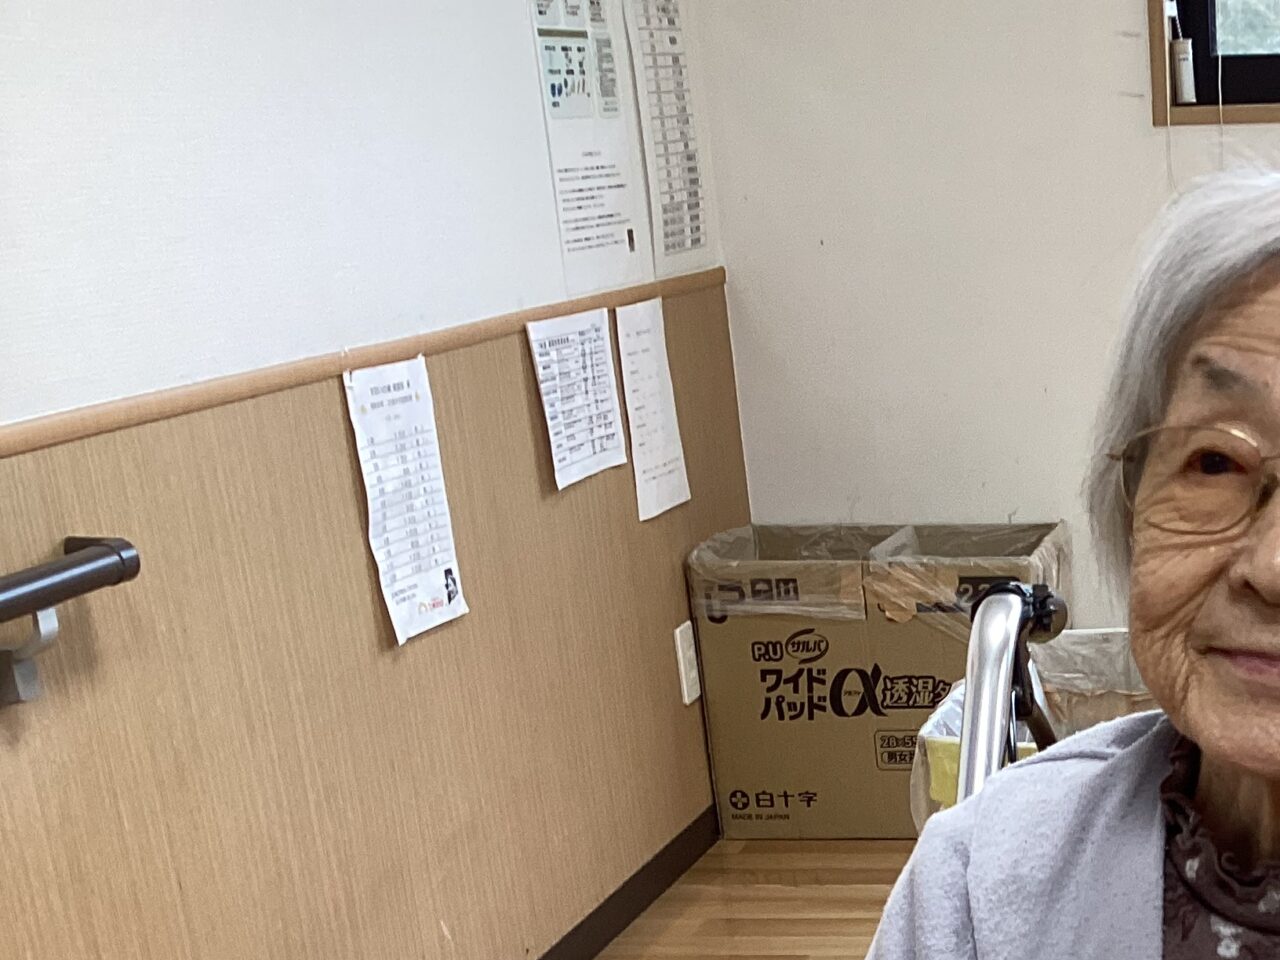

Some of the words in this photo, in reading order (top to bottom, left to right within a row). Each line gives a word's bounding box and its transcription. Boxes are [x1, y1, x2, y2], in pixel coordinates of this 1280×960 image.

[760, 667, 827, 694] ワイド
[760, 694, 827, 721] パッド
[755, 790, 818, 809] 白十字
